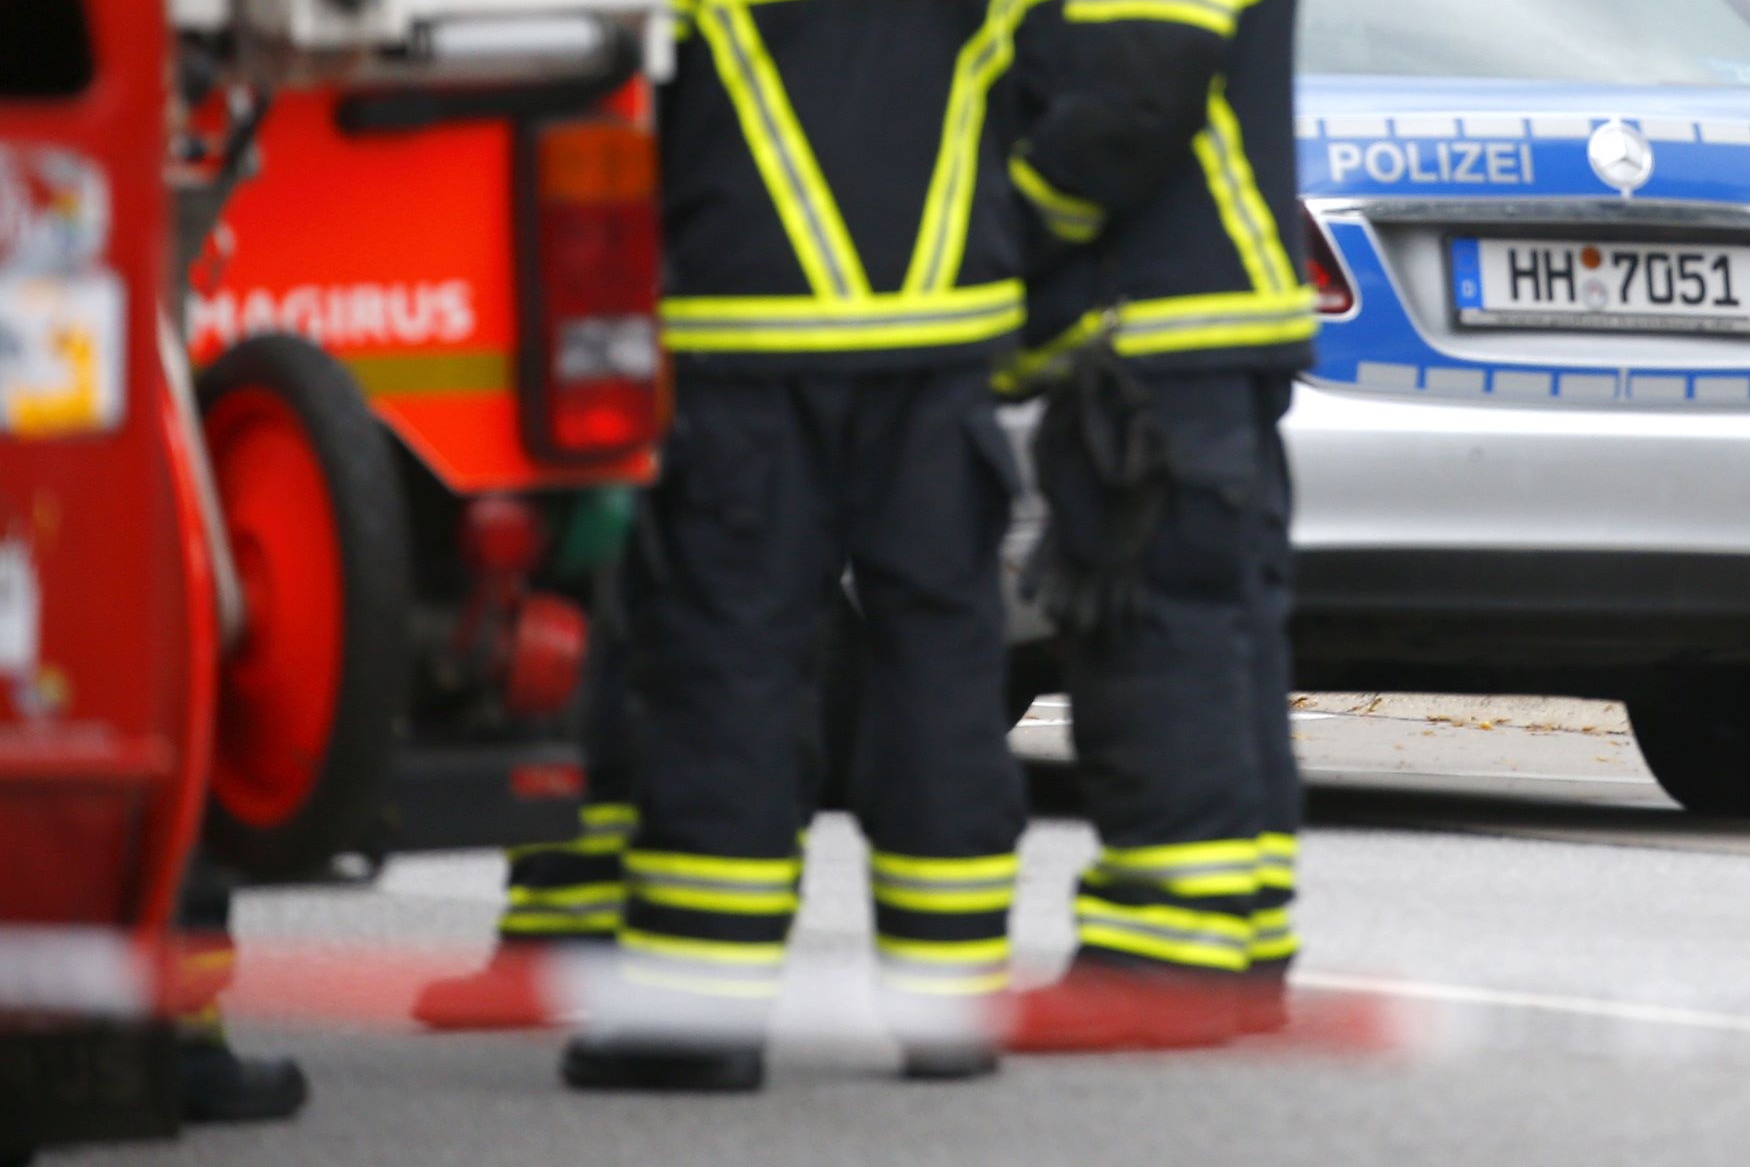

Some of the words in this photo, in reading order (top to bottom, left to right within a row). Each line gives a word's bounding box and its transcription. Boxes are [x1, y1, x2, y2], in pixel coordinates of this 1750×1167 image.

[1327, 141, 1535, 184] POLIZEI
[1508, 248, 1576, 303] HH
[1611, 252, 1740, 308] 7051
